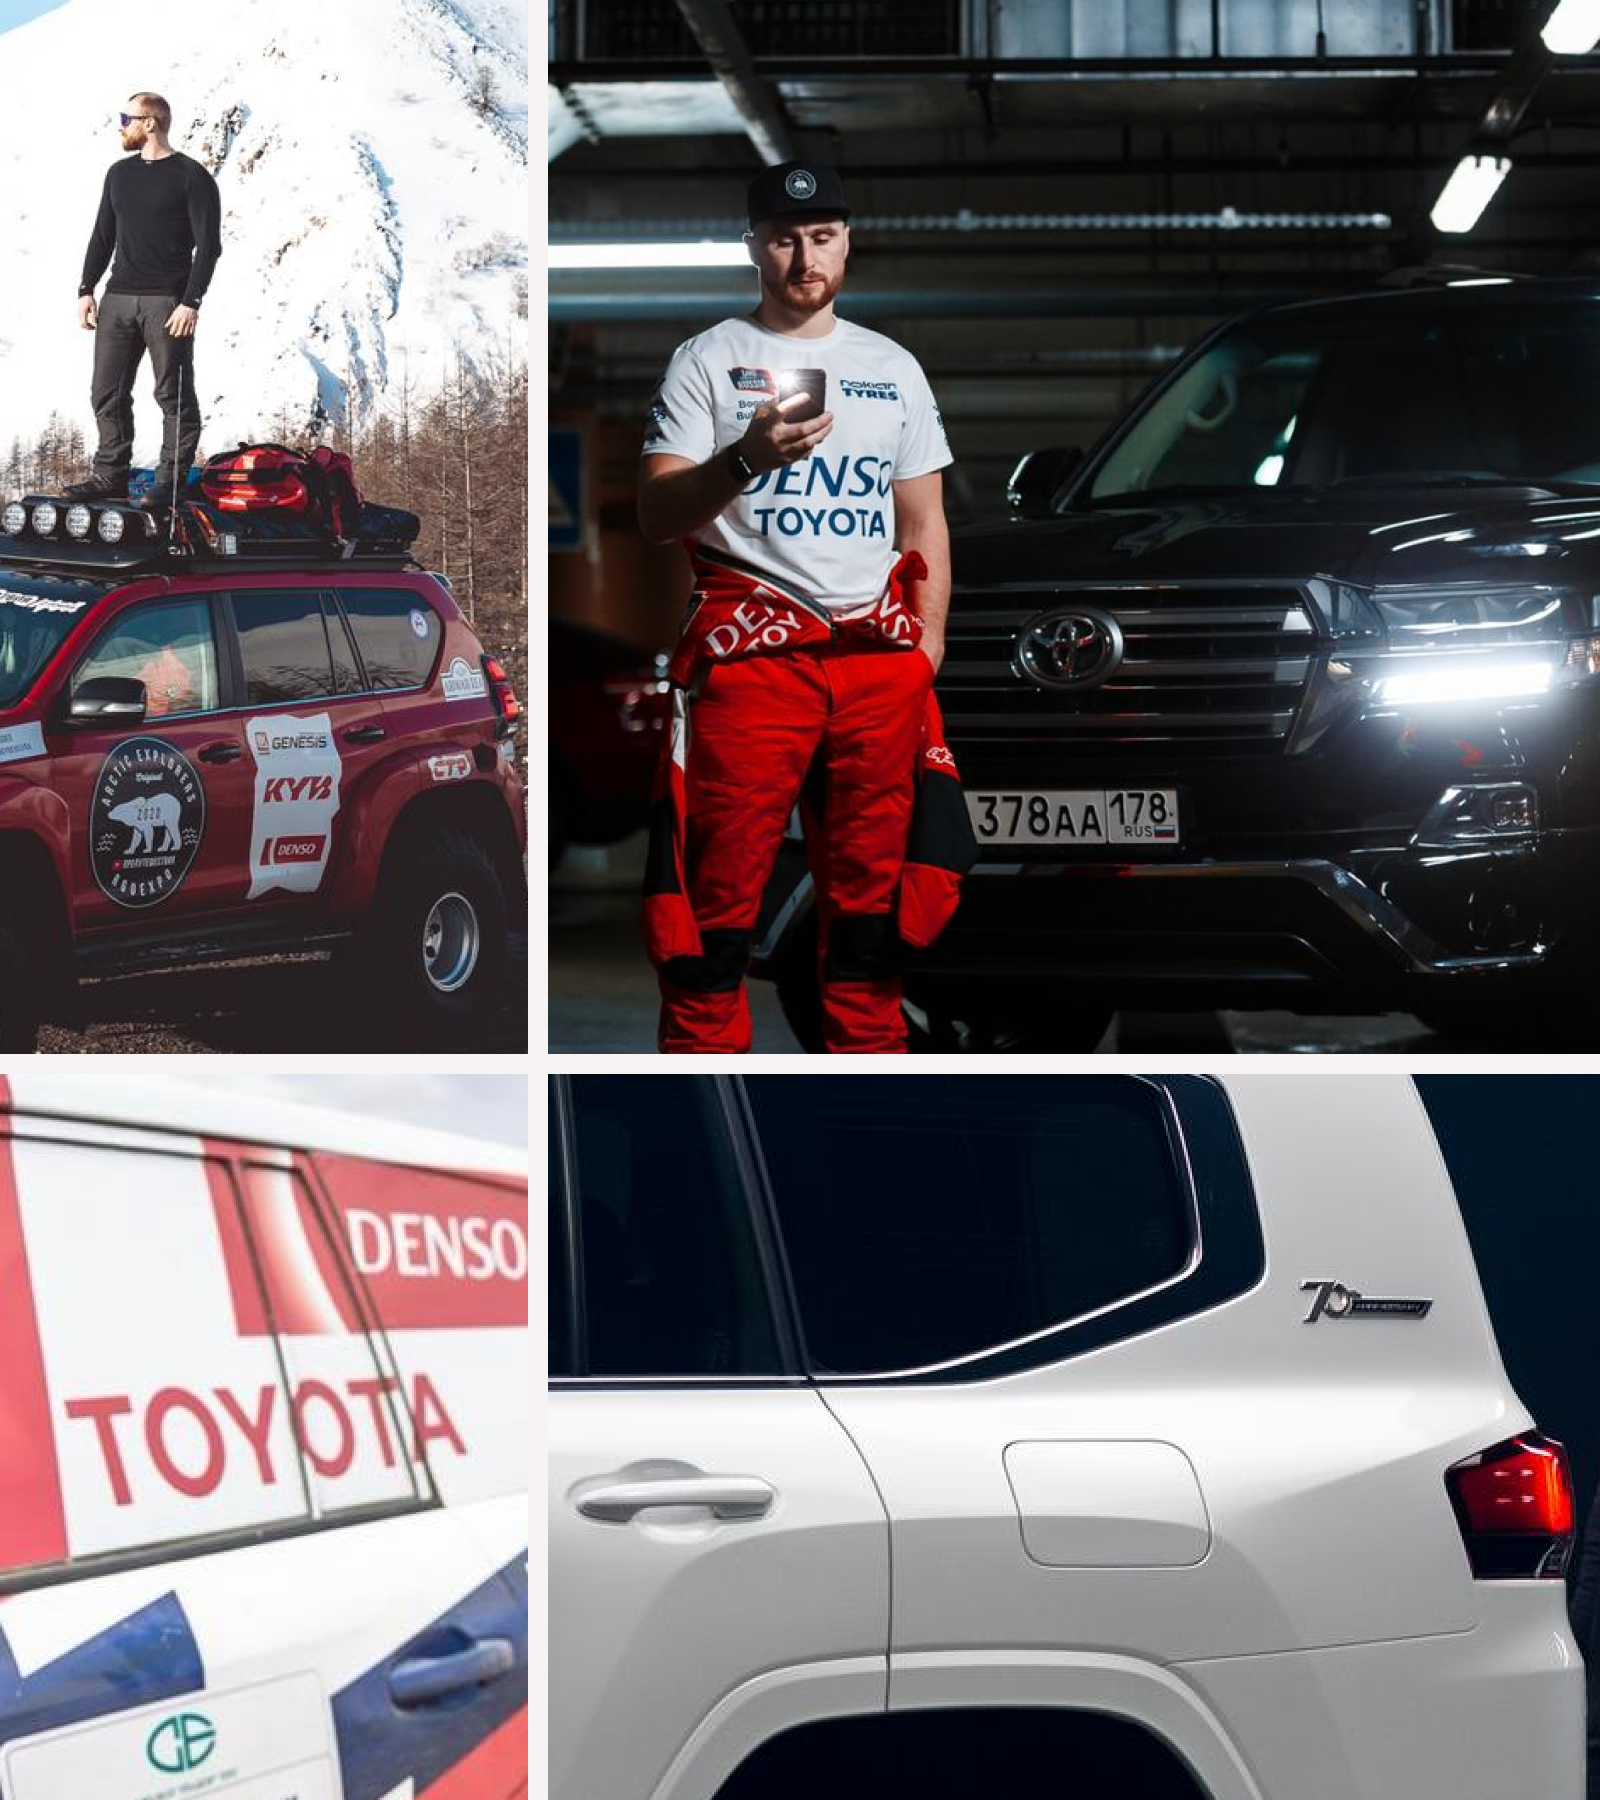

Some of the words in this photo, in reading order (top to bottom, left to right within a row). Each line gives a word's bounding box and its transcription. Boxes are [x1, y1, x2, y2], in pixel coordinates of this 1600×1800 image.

[842, 388, 898, 401] TYRES
[754, 506, 886, 538] TOYOTA
[272, 735, 327, 750] GENESIS
[136, 749, 196, 803] EXPLORERS
[263, 775, 333, 803] KYB
[1108, 792, 1167, 825] 178
[1124, 825, 1153, 838] RUS
[278, 843, 317, 856] DENSO
[345, 1207, 528, 1281] DENSO
[65, 1373, 467, 1507] TOYOTA
